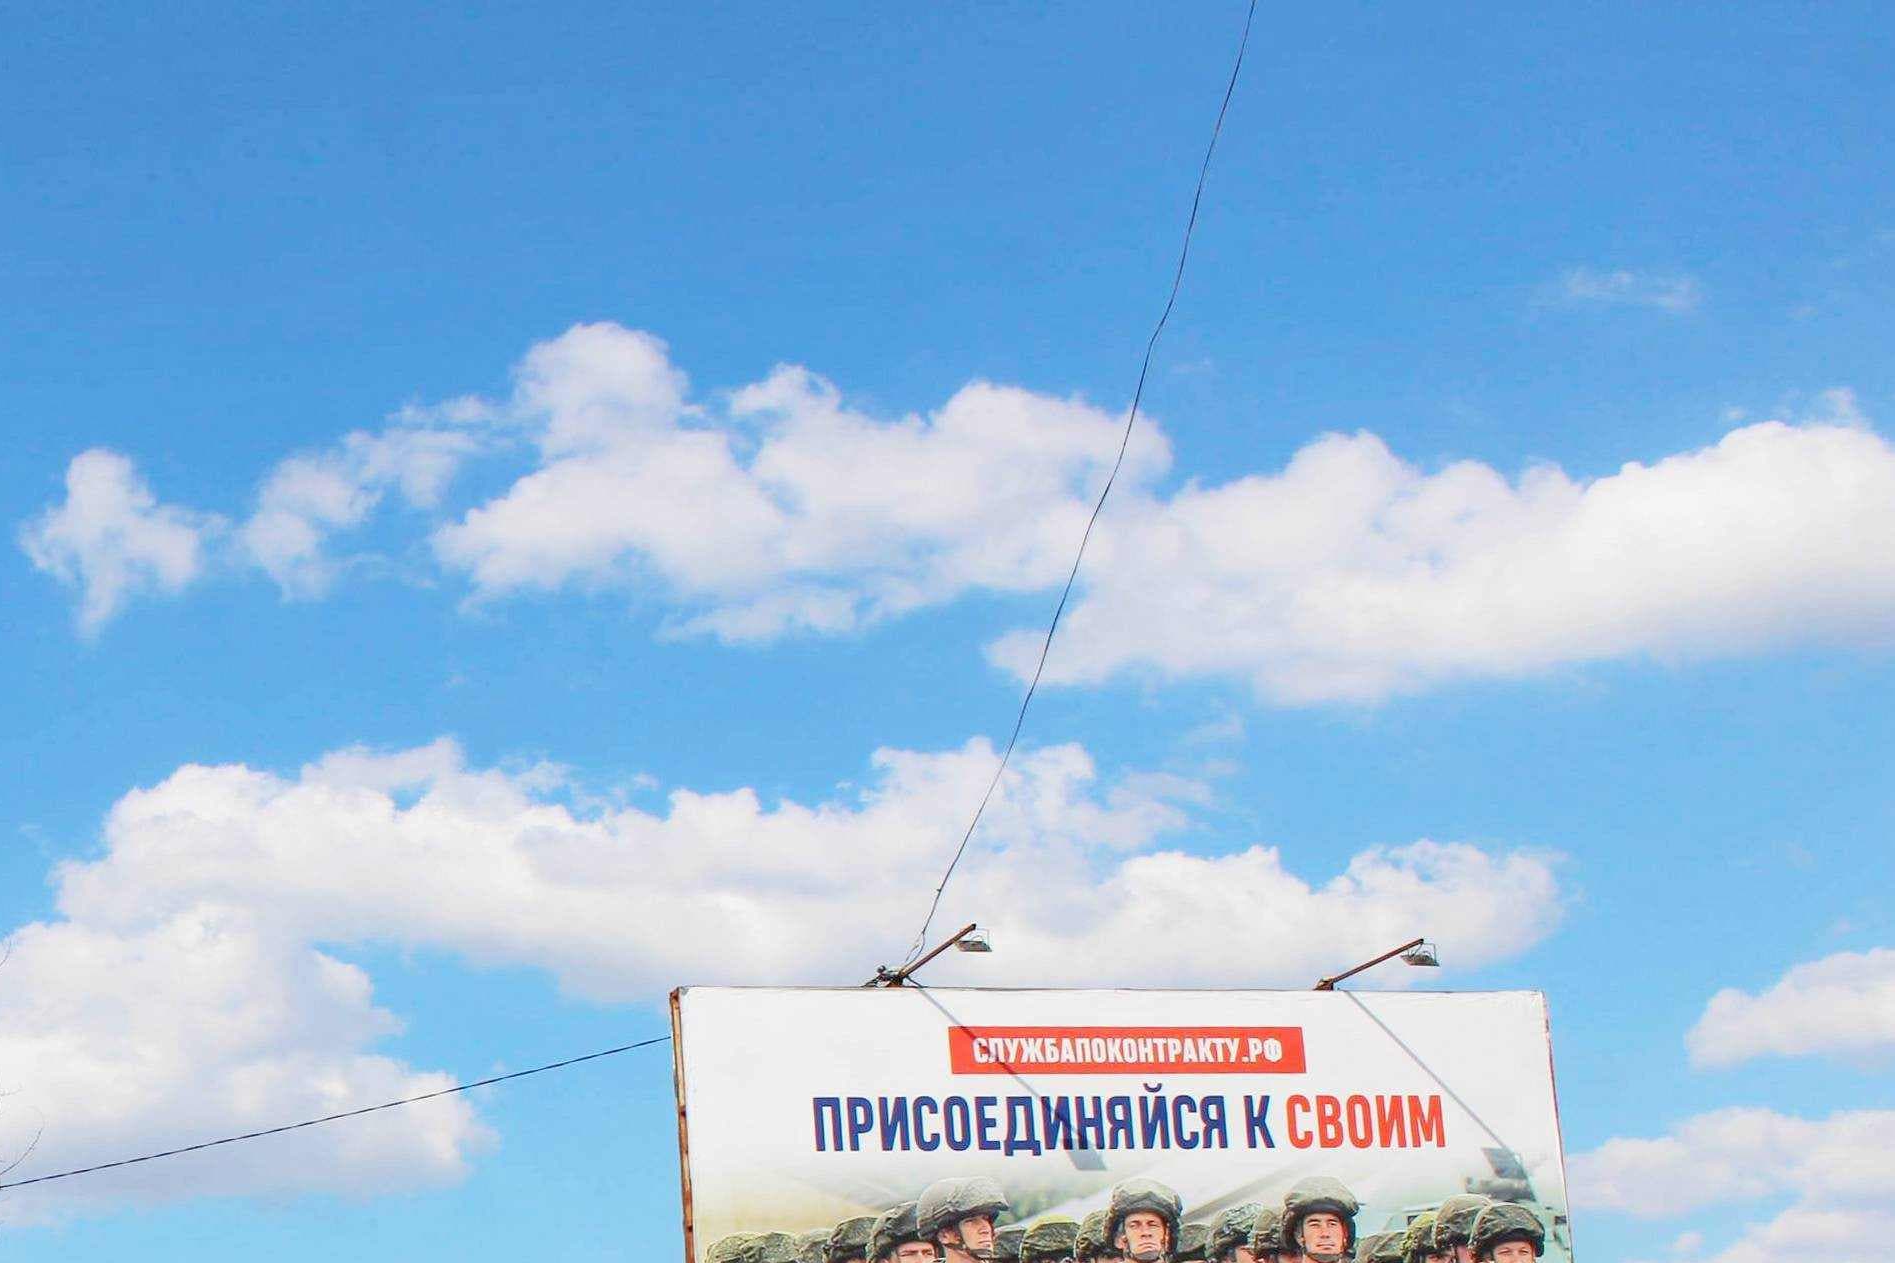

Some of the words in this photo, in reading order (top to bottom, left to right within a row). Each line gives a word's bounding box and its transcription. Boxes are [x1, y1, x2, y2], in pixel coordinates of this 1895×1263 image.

[973, 1037, 1283, 1064] СЛУЖБАПОКОНТРАКТУ.РФ
[812, 1082, 1229, 1157] ПРИСОЕДИНЯЙСЯ
[1243, 1095, 1276, 1149] К
[1286, 1094, 1447, 1149] СВОИМ
